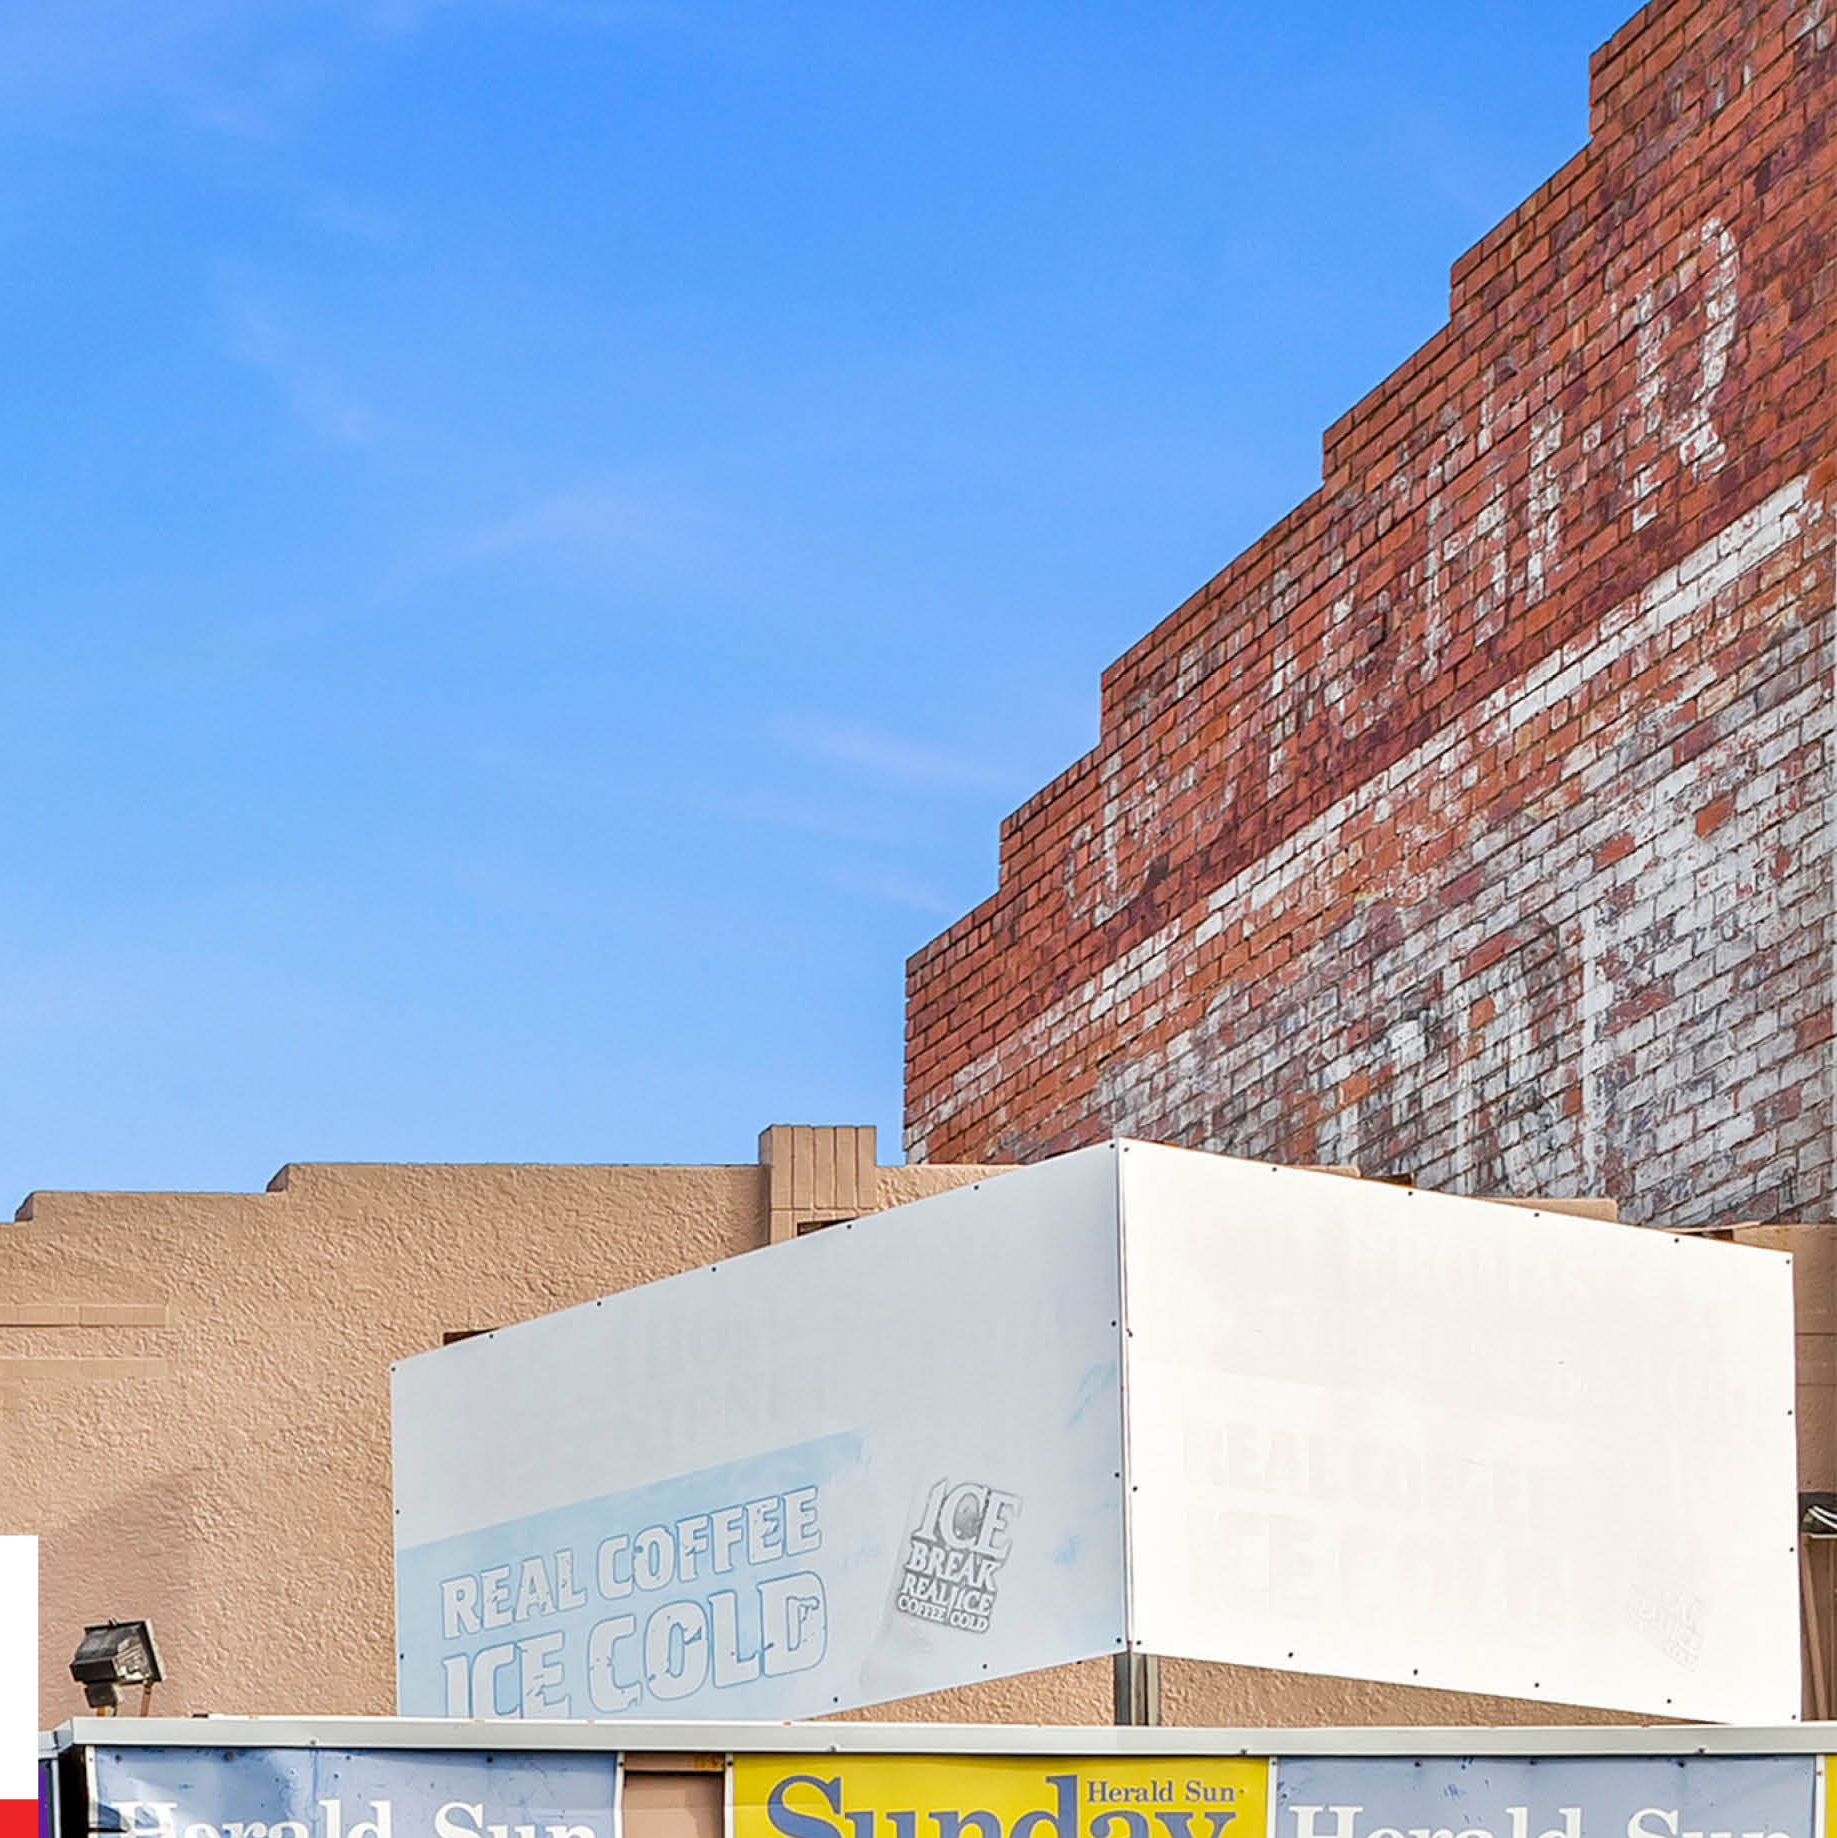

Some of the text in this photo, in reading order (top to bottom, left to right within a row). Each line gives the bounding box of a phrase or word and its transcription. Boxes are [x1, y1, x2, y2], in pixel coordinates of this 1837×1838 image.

[911, 1478, 1023, 1560] ICE
[440, 1485, 823, 1640] REAL COFFEE
[904, 1539, 1001, 1592] BREAK
[900, 1573, 950, 1607] REAL
[955, 1588, 995, 1617] ICE
[950, 1611, 989, 1632] COLD
[442, 1570, 828, 1718] ICE COLD
[1086, 1780, 1235, 1803] Herald Sun
